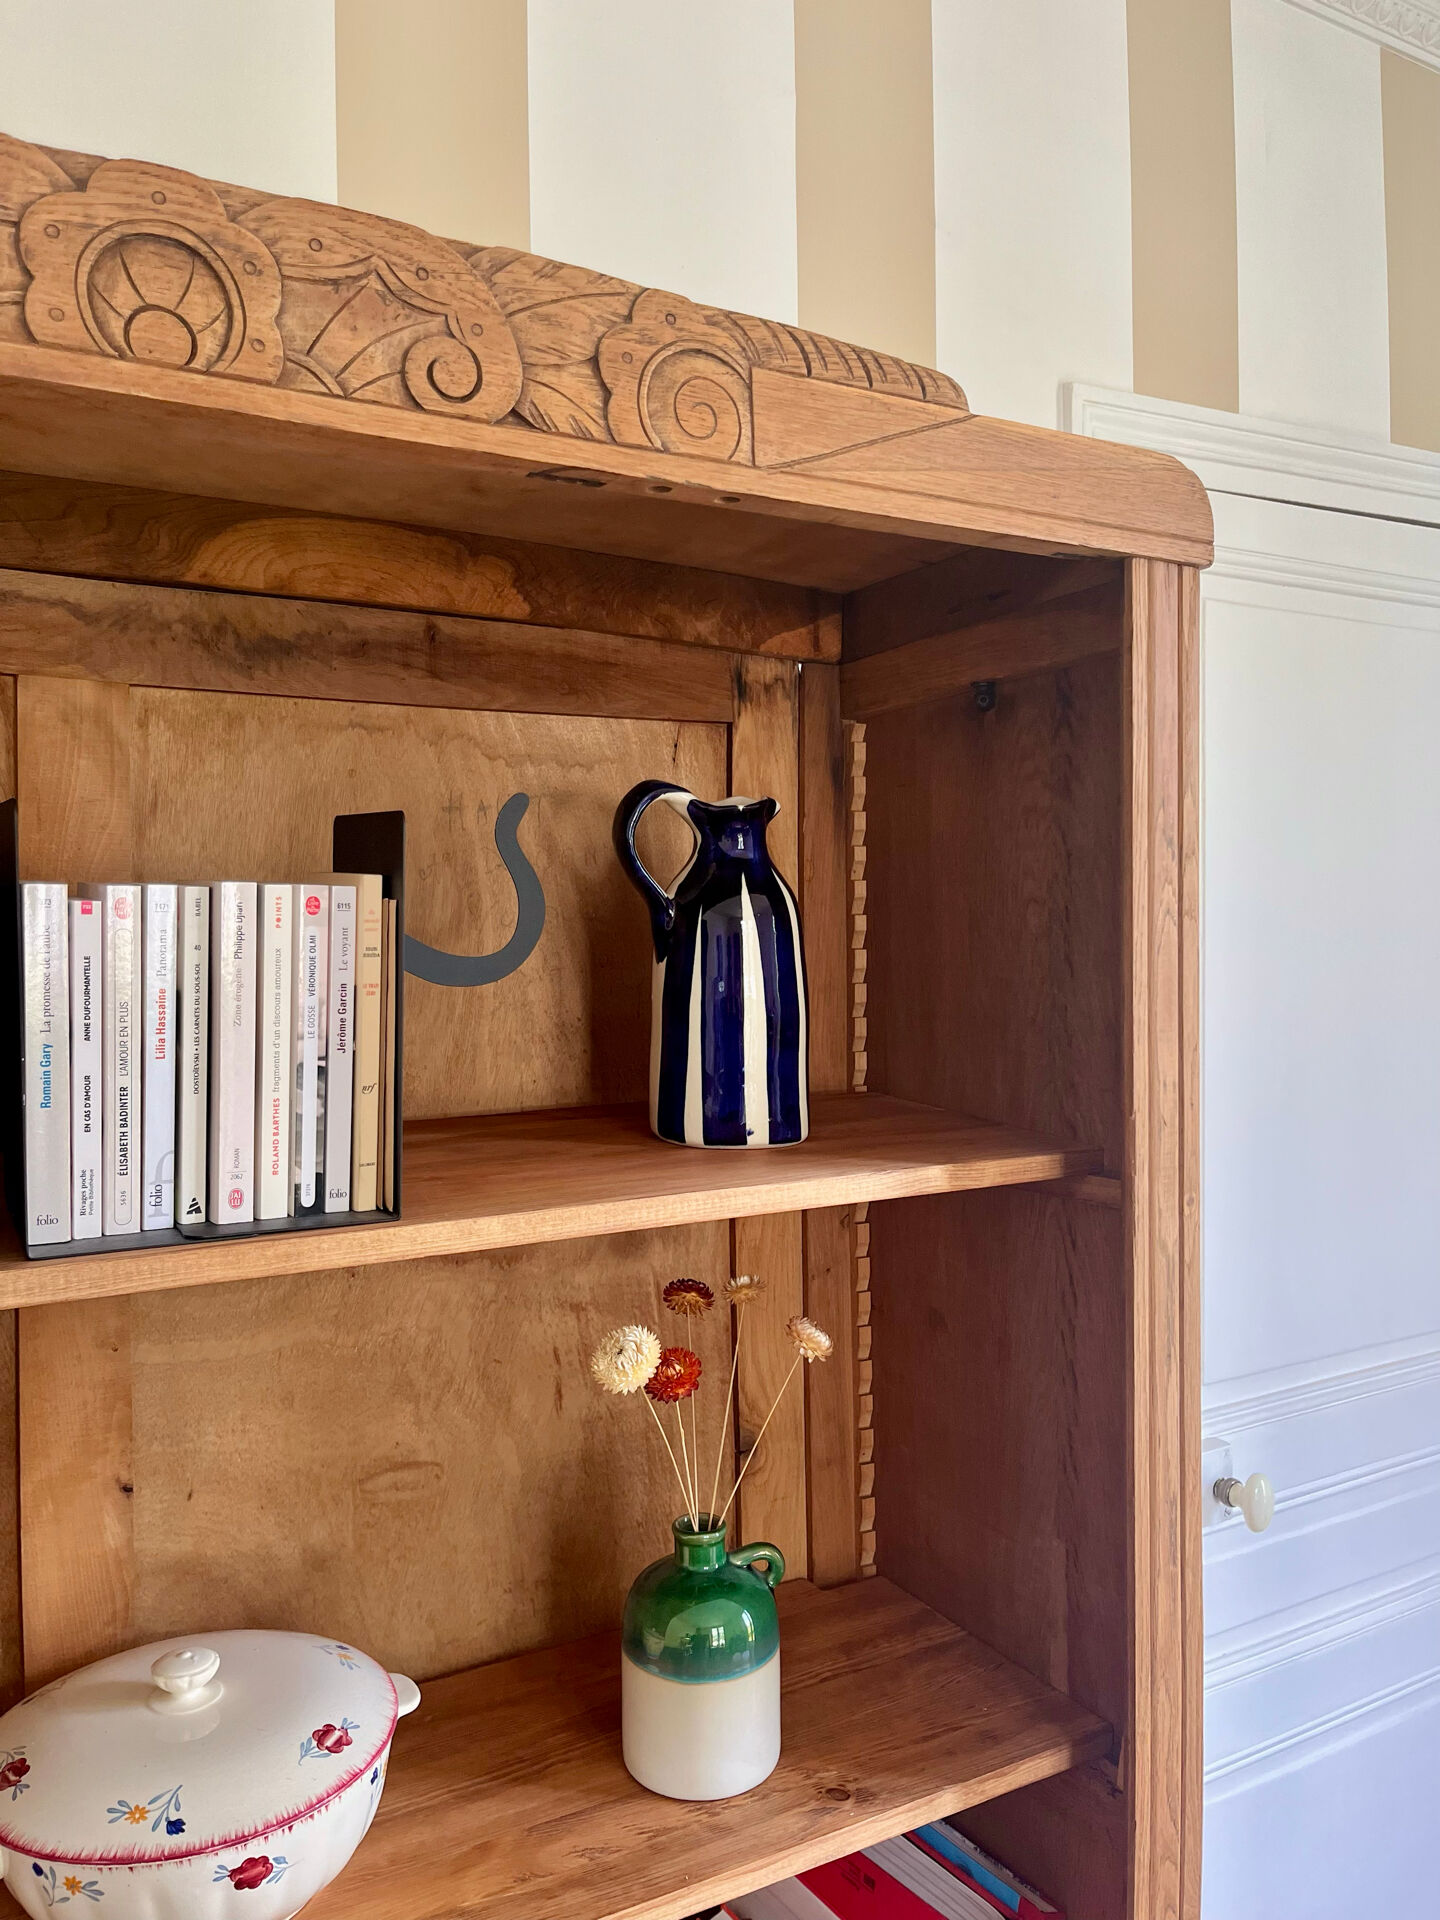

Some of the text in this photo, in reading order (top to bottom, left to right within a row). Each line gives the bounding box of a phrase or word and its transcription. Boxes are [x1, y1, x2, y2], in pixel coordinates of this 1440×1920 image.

[275, 896, 283, 929] POINTS
[233, 925, 245, 960] Philippe
[40, 957, 51, 970] de
[42, 970, 54, 1018] promesse
[83, 955, 91, 1042] ANNE DUFOURMANTELLE
[155, 929, 168, 1060] Lilia Hassaine Panorama
[193, 995, 201, 1006] DU
[306, 935, 317, 1039] LE GOSSE VÉRONIQUE OLMI
[336, 927, 352, 1054] Jérôme Garcin Le voyant
[39, 1020, 51, 1034] La
[193, 1007, 201, 1036] CARNETS
[233, 1004, 242, 1027] Zone
[39, 1043, 54, 1068] Gary
[272, 948, 282, 1176] ROLAND BARTHES fragments d'un discours amoureux
[39, 1070, 52, 1109] Romain
[83, 1075, 91, 1133] EN CAS D'AMOUR
[117, 1001, 129, 1177] ÉLISABETH BADINTER L'AMOUR EN PLUS
[362, 1082, 377, 1095] nrf
[79, 1169, 88, 1217] Rivages poche
[149, 1184, 163, 1207] folio
[329, 1188, 348, 1200] folio
[36, 1214, 59, 1226] folio
